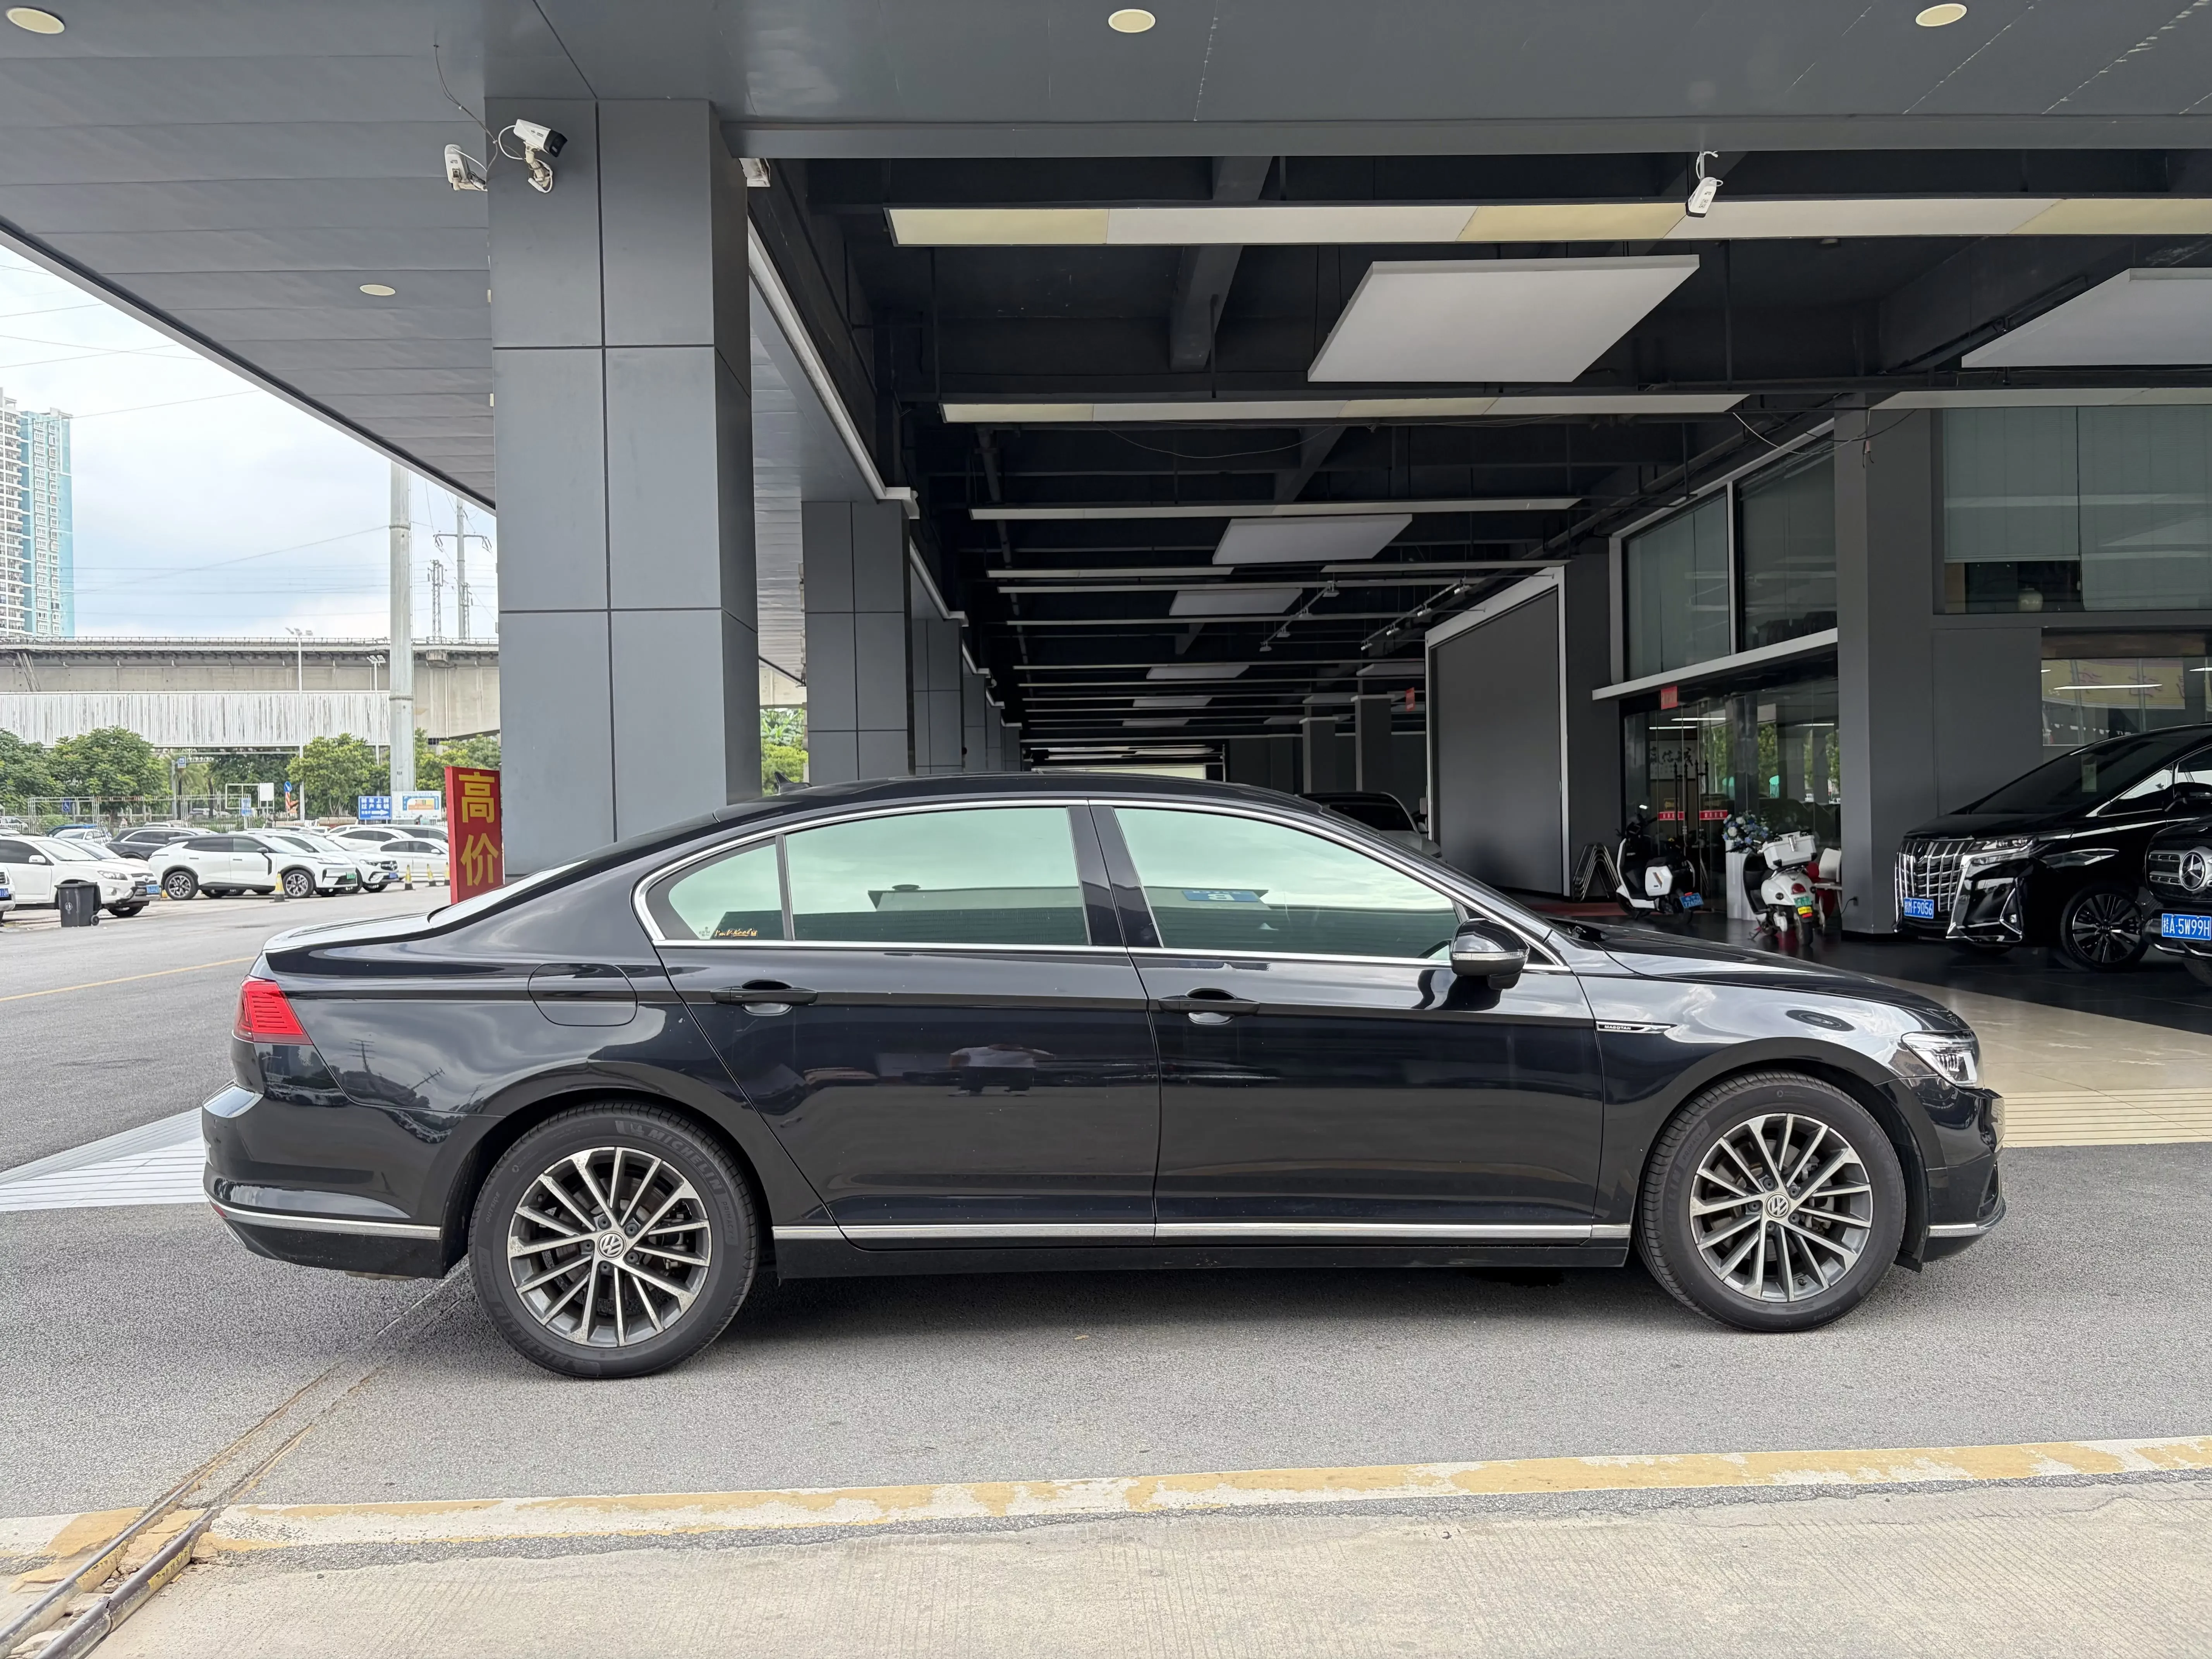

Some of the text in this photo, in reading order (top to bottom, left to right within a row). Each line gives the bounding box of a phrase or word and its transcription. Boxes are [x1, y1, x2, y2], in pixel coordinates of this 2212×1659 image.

[459, 772, 498, 886] 高价
[647, 1128, 723, 1190] MICHELIN
[486, 1191, 501, 1223] OUTSIDE
